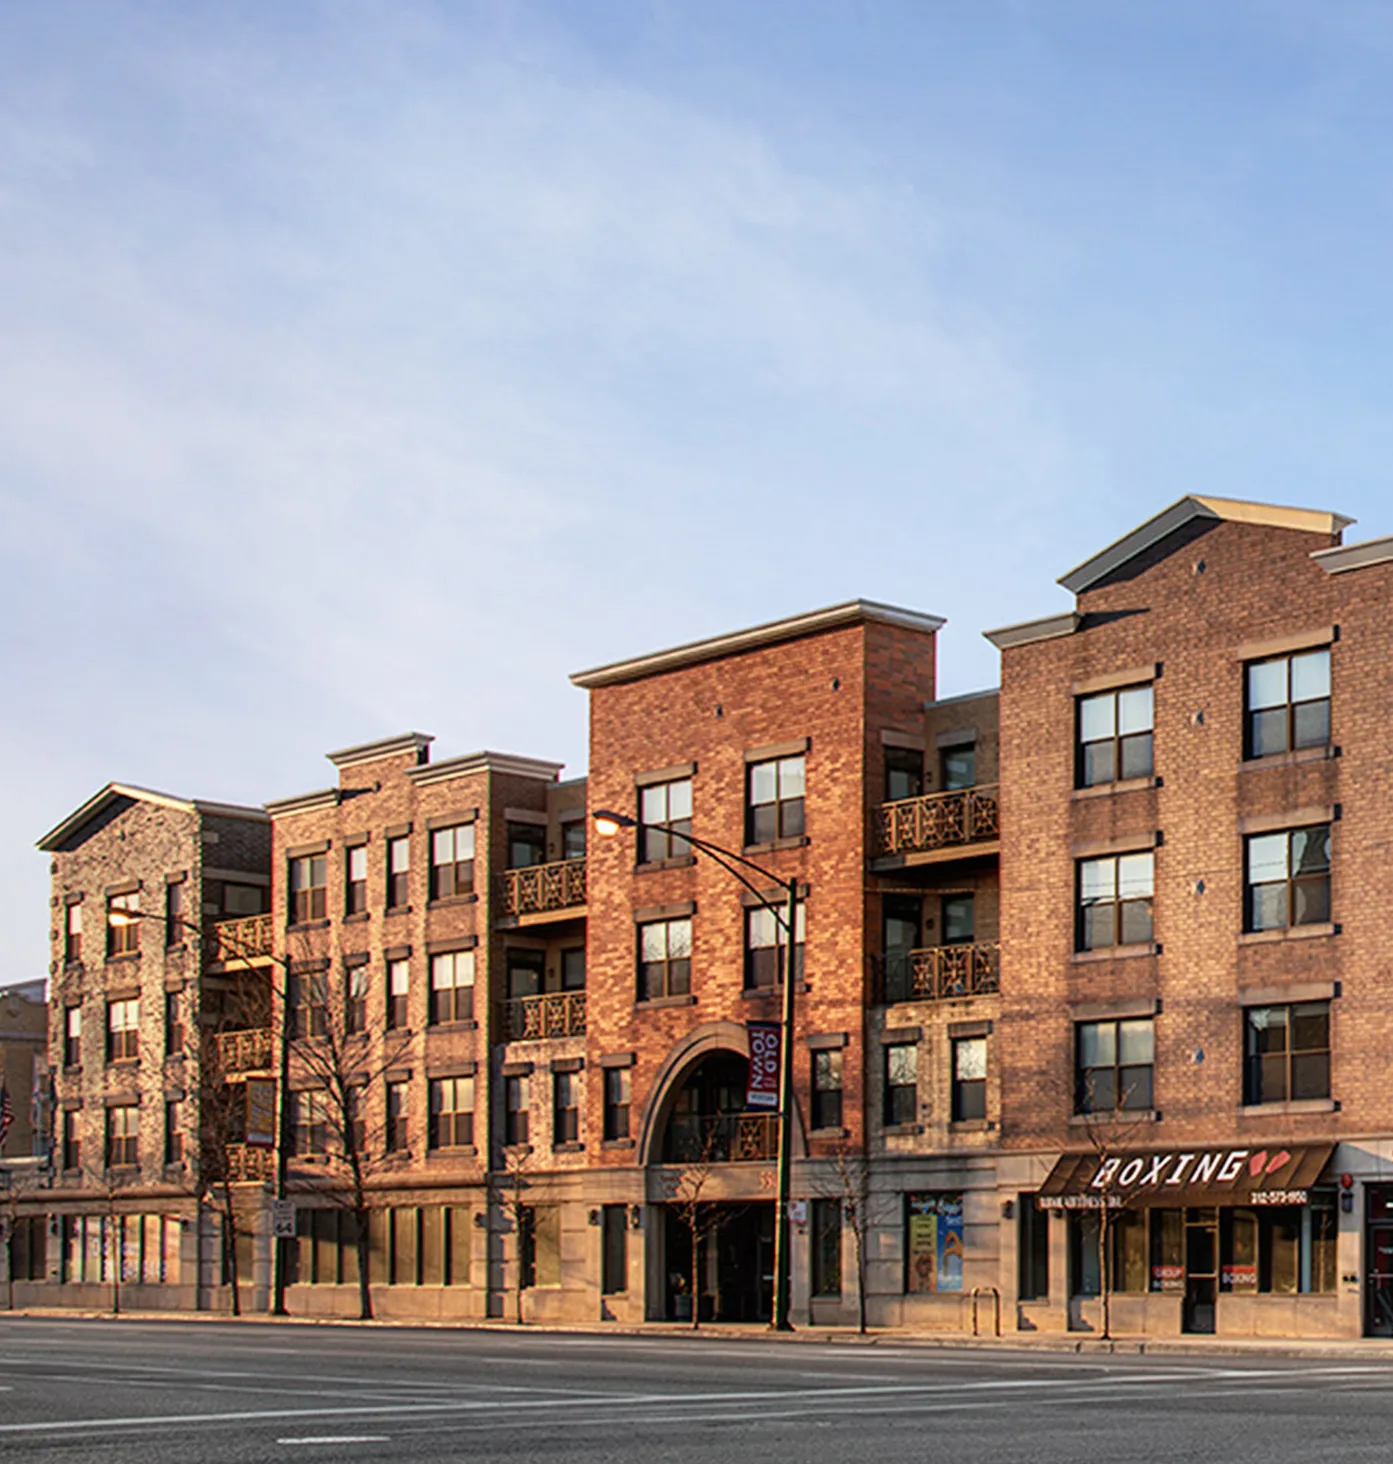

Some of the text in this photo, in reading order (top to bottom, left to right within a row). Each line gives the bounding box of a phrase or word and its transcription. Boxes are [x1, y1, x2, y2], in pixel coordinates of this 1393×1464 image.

[751, 1032, 765, 1088] TOWN
[765, 1034, 778, 1073] OLD
[1091, 1151, 1249, 1188] BOXING
